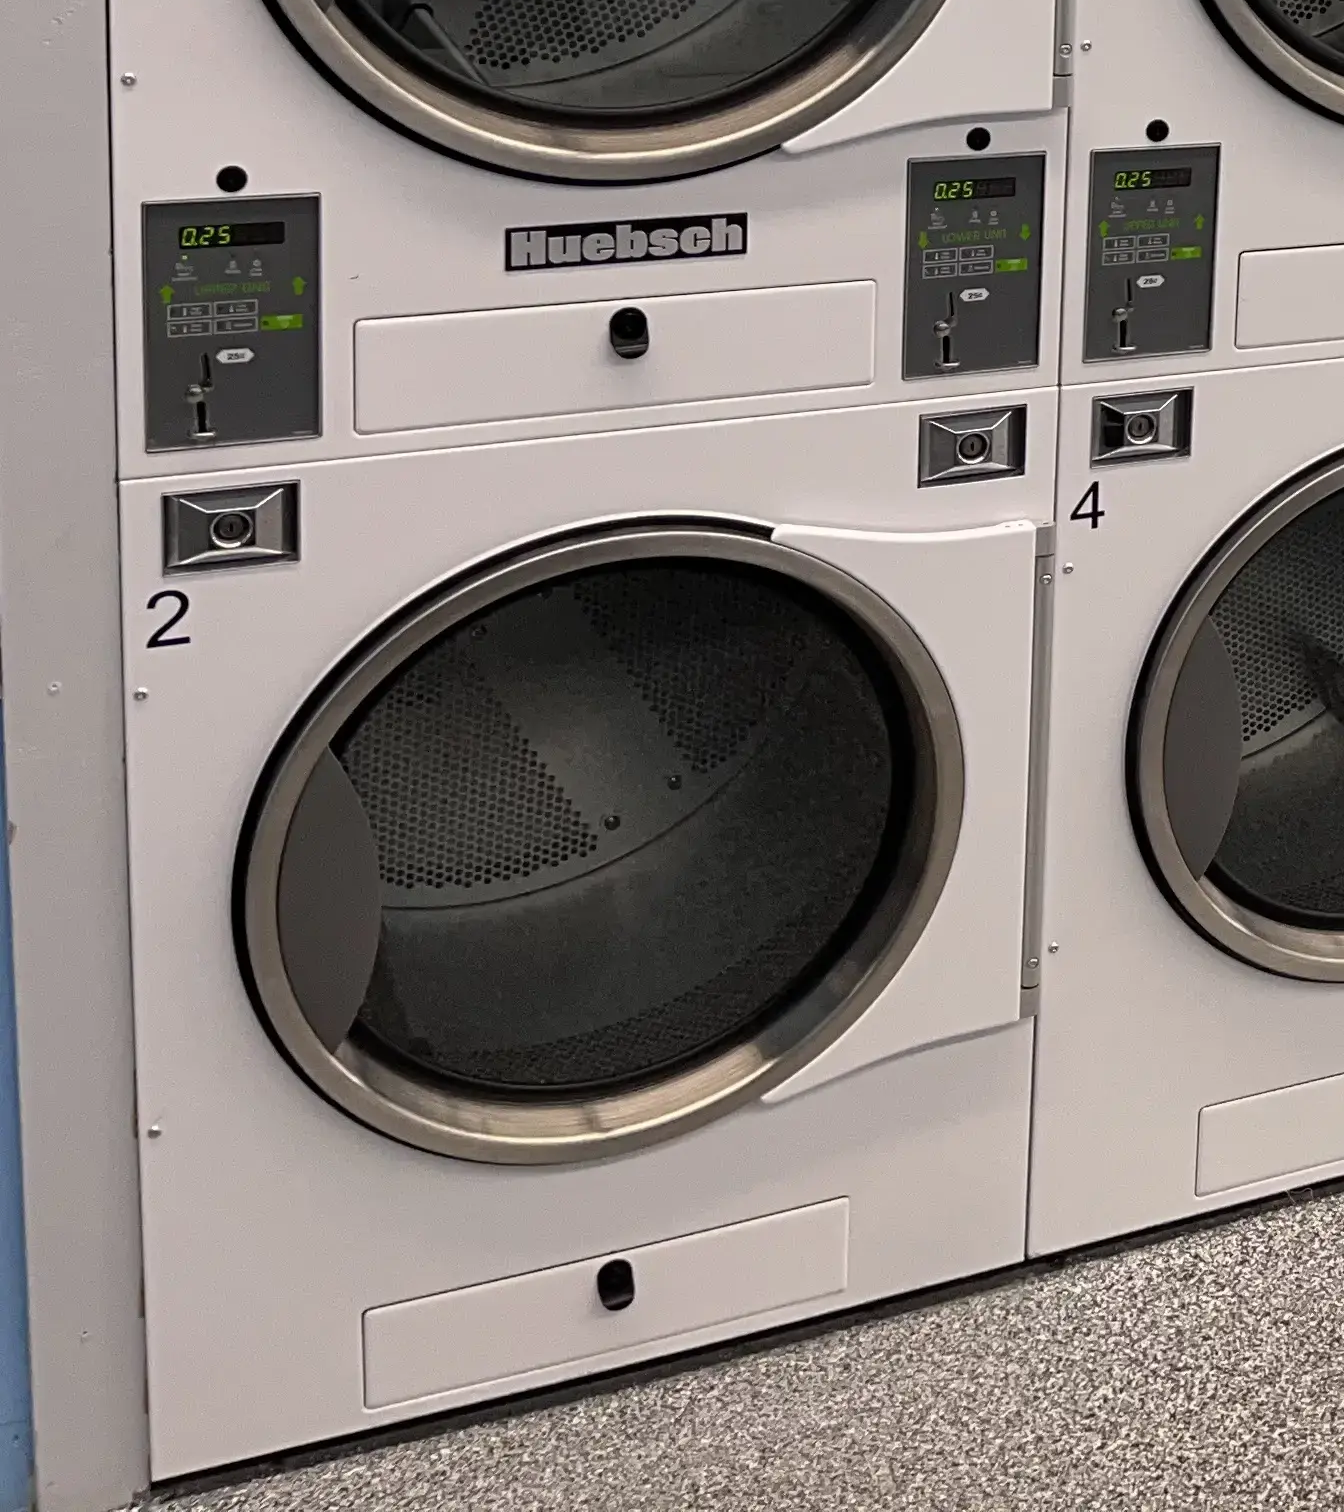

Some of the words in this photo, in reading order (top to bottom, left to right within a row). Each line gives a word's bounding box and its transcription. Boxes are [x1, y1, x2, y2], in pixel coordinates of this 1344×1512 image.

[934, 180, 974, 200] 0.25
[1114, 171, 1152, 189] 0.25
[181, 225, 231, 247] 0.25
[509, 217, 743, 267] Huebsch
[1069, 480, 1106, 530] 4
[145, 589, 192, 649] 2
